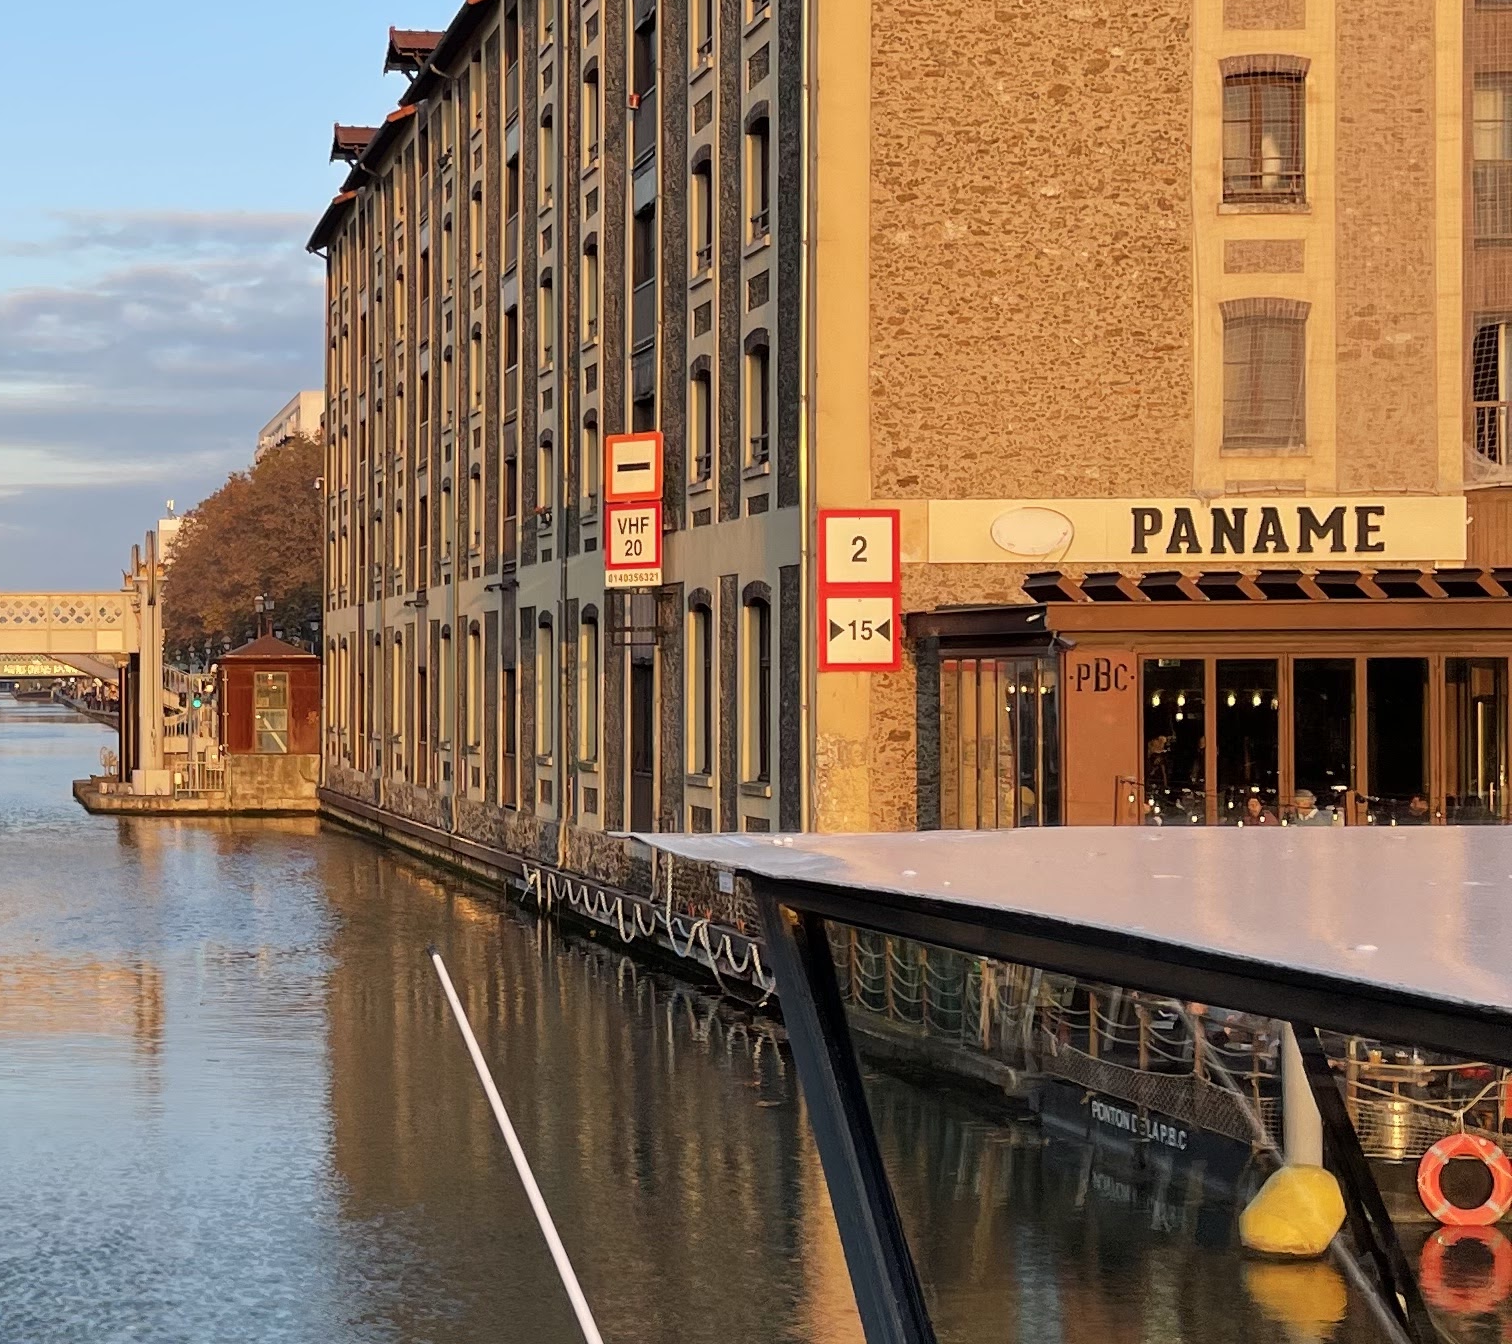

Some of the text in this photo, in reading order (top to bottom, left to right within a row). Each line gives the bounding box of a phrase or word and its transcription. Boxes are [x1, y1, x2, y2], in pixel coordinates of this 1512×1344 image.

[617, 516, 650, 535] VHF
[1131, 506, 1385, 554] PANAME
[624, 538, 643, 557] 20
[851, 535, 868, 563] 2
[608, 572, 659, 583] 0140356321
[848, 619, 873, 641] 15
